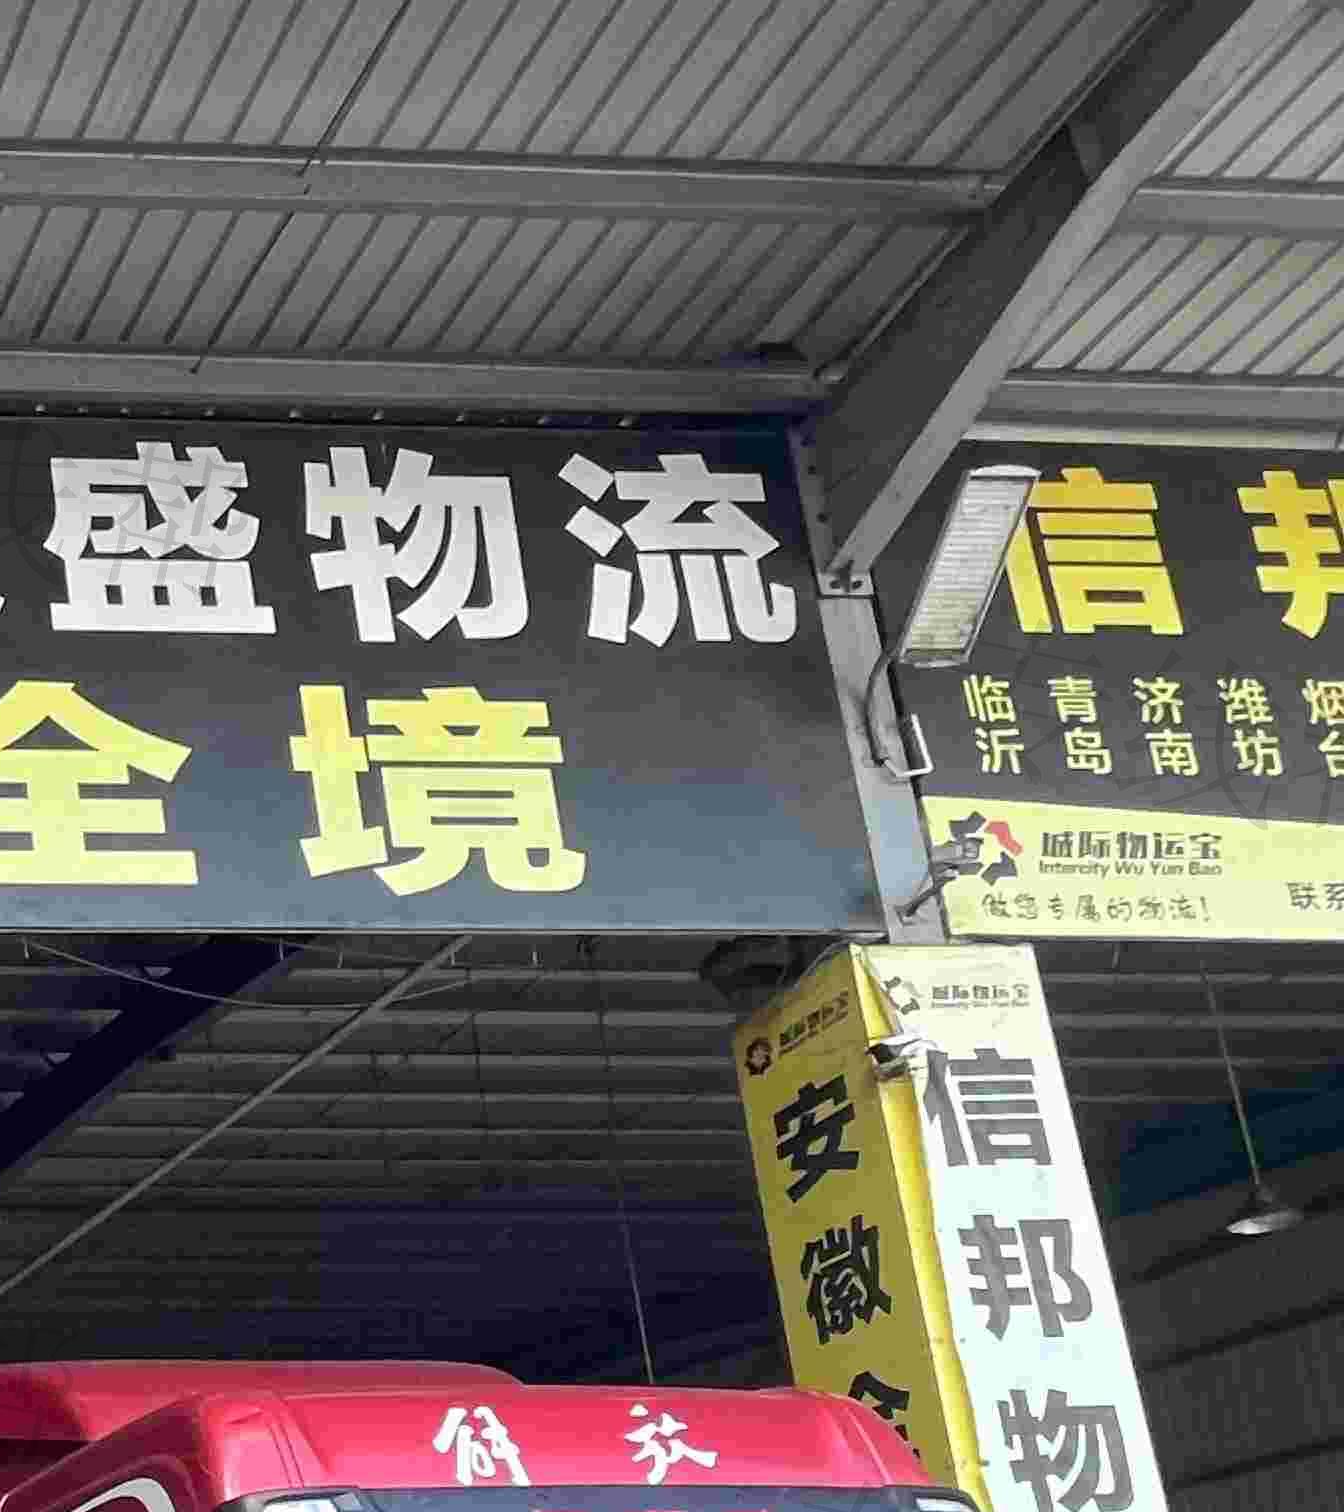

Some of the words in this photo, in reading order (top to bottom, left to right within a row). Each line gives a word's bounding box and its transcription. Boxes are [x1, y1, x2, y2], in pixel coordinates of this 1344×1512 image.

[1040, 832, 1223, 860] 城际物运宝
[1039, 860, 1108, 877] Intercity
[1114, 861, 1144, 875] Wu
[1150, 861, 1184, 875] Yun
